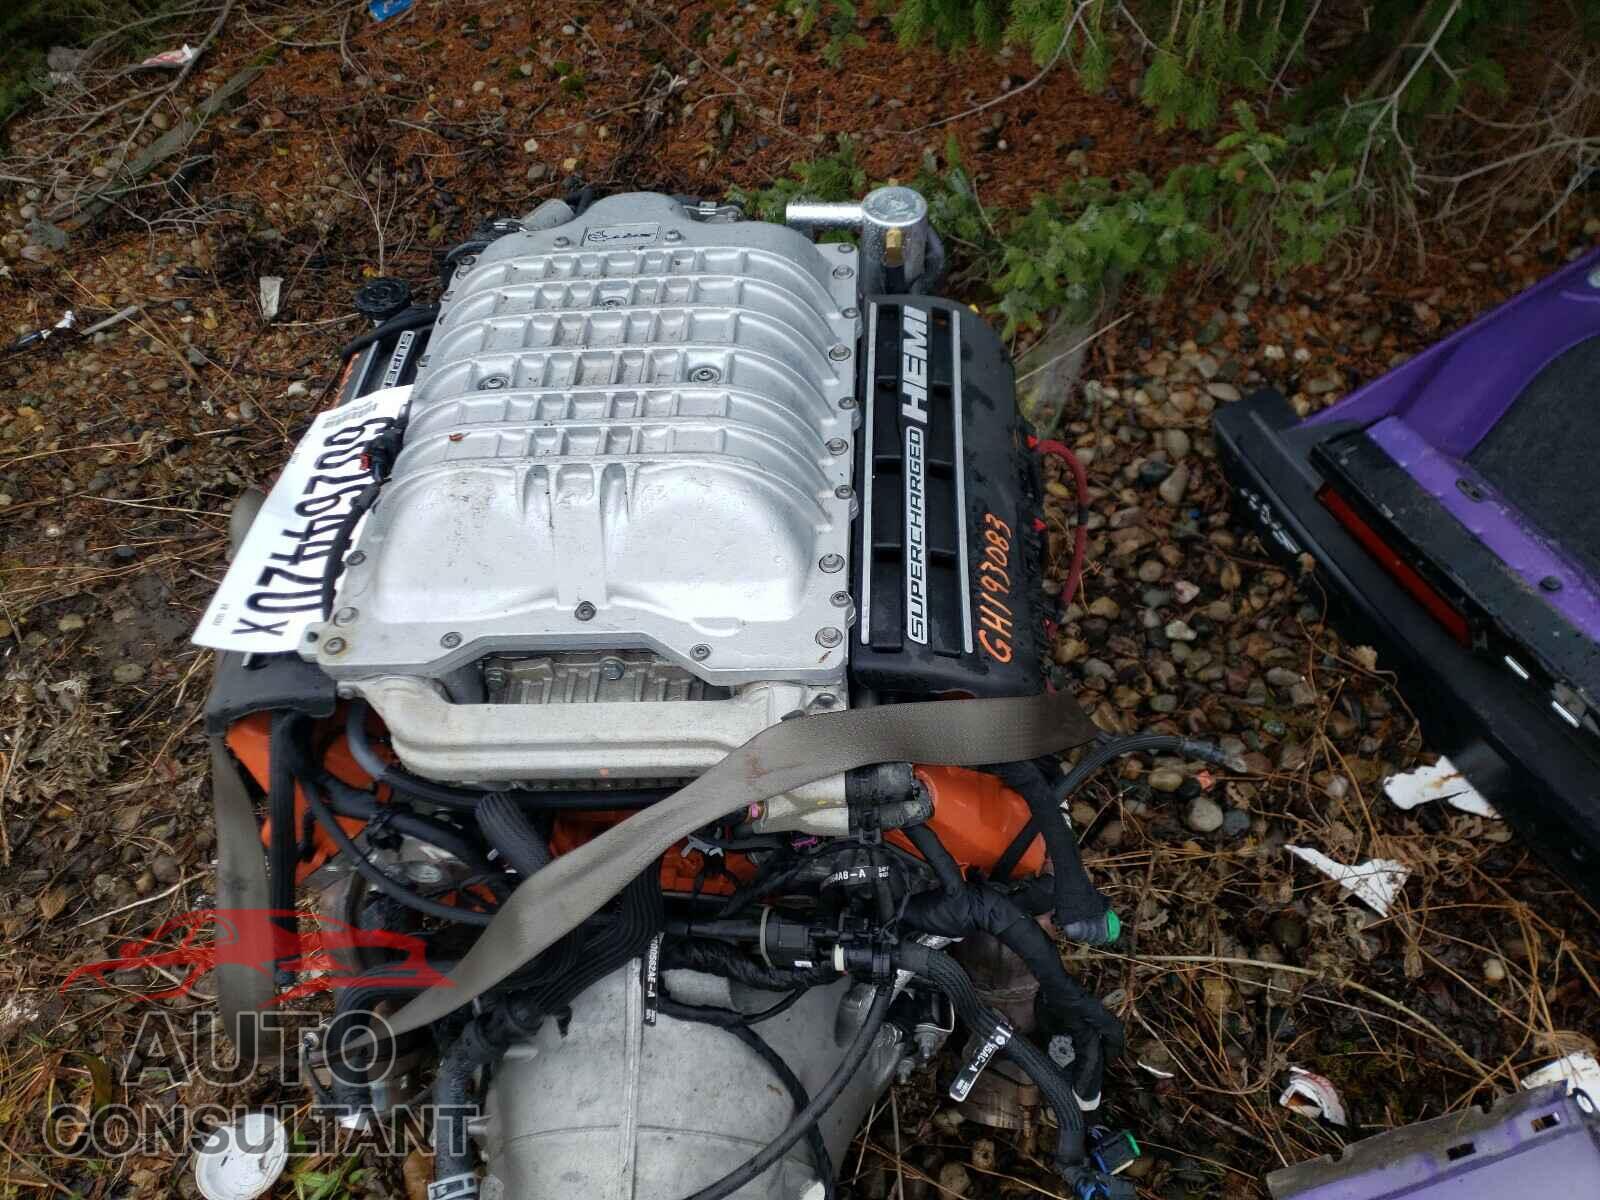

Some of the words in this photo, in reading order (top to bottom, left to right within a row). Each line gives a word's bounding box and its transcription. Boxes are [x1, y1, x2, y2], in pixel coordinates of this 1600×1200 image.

[900, 306, 928, 424] HEMI
[907, 426, 926, 642] SUPERCHARGED
[979, 512, 1013, 663] GH193083
